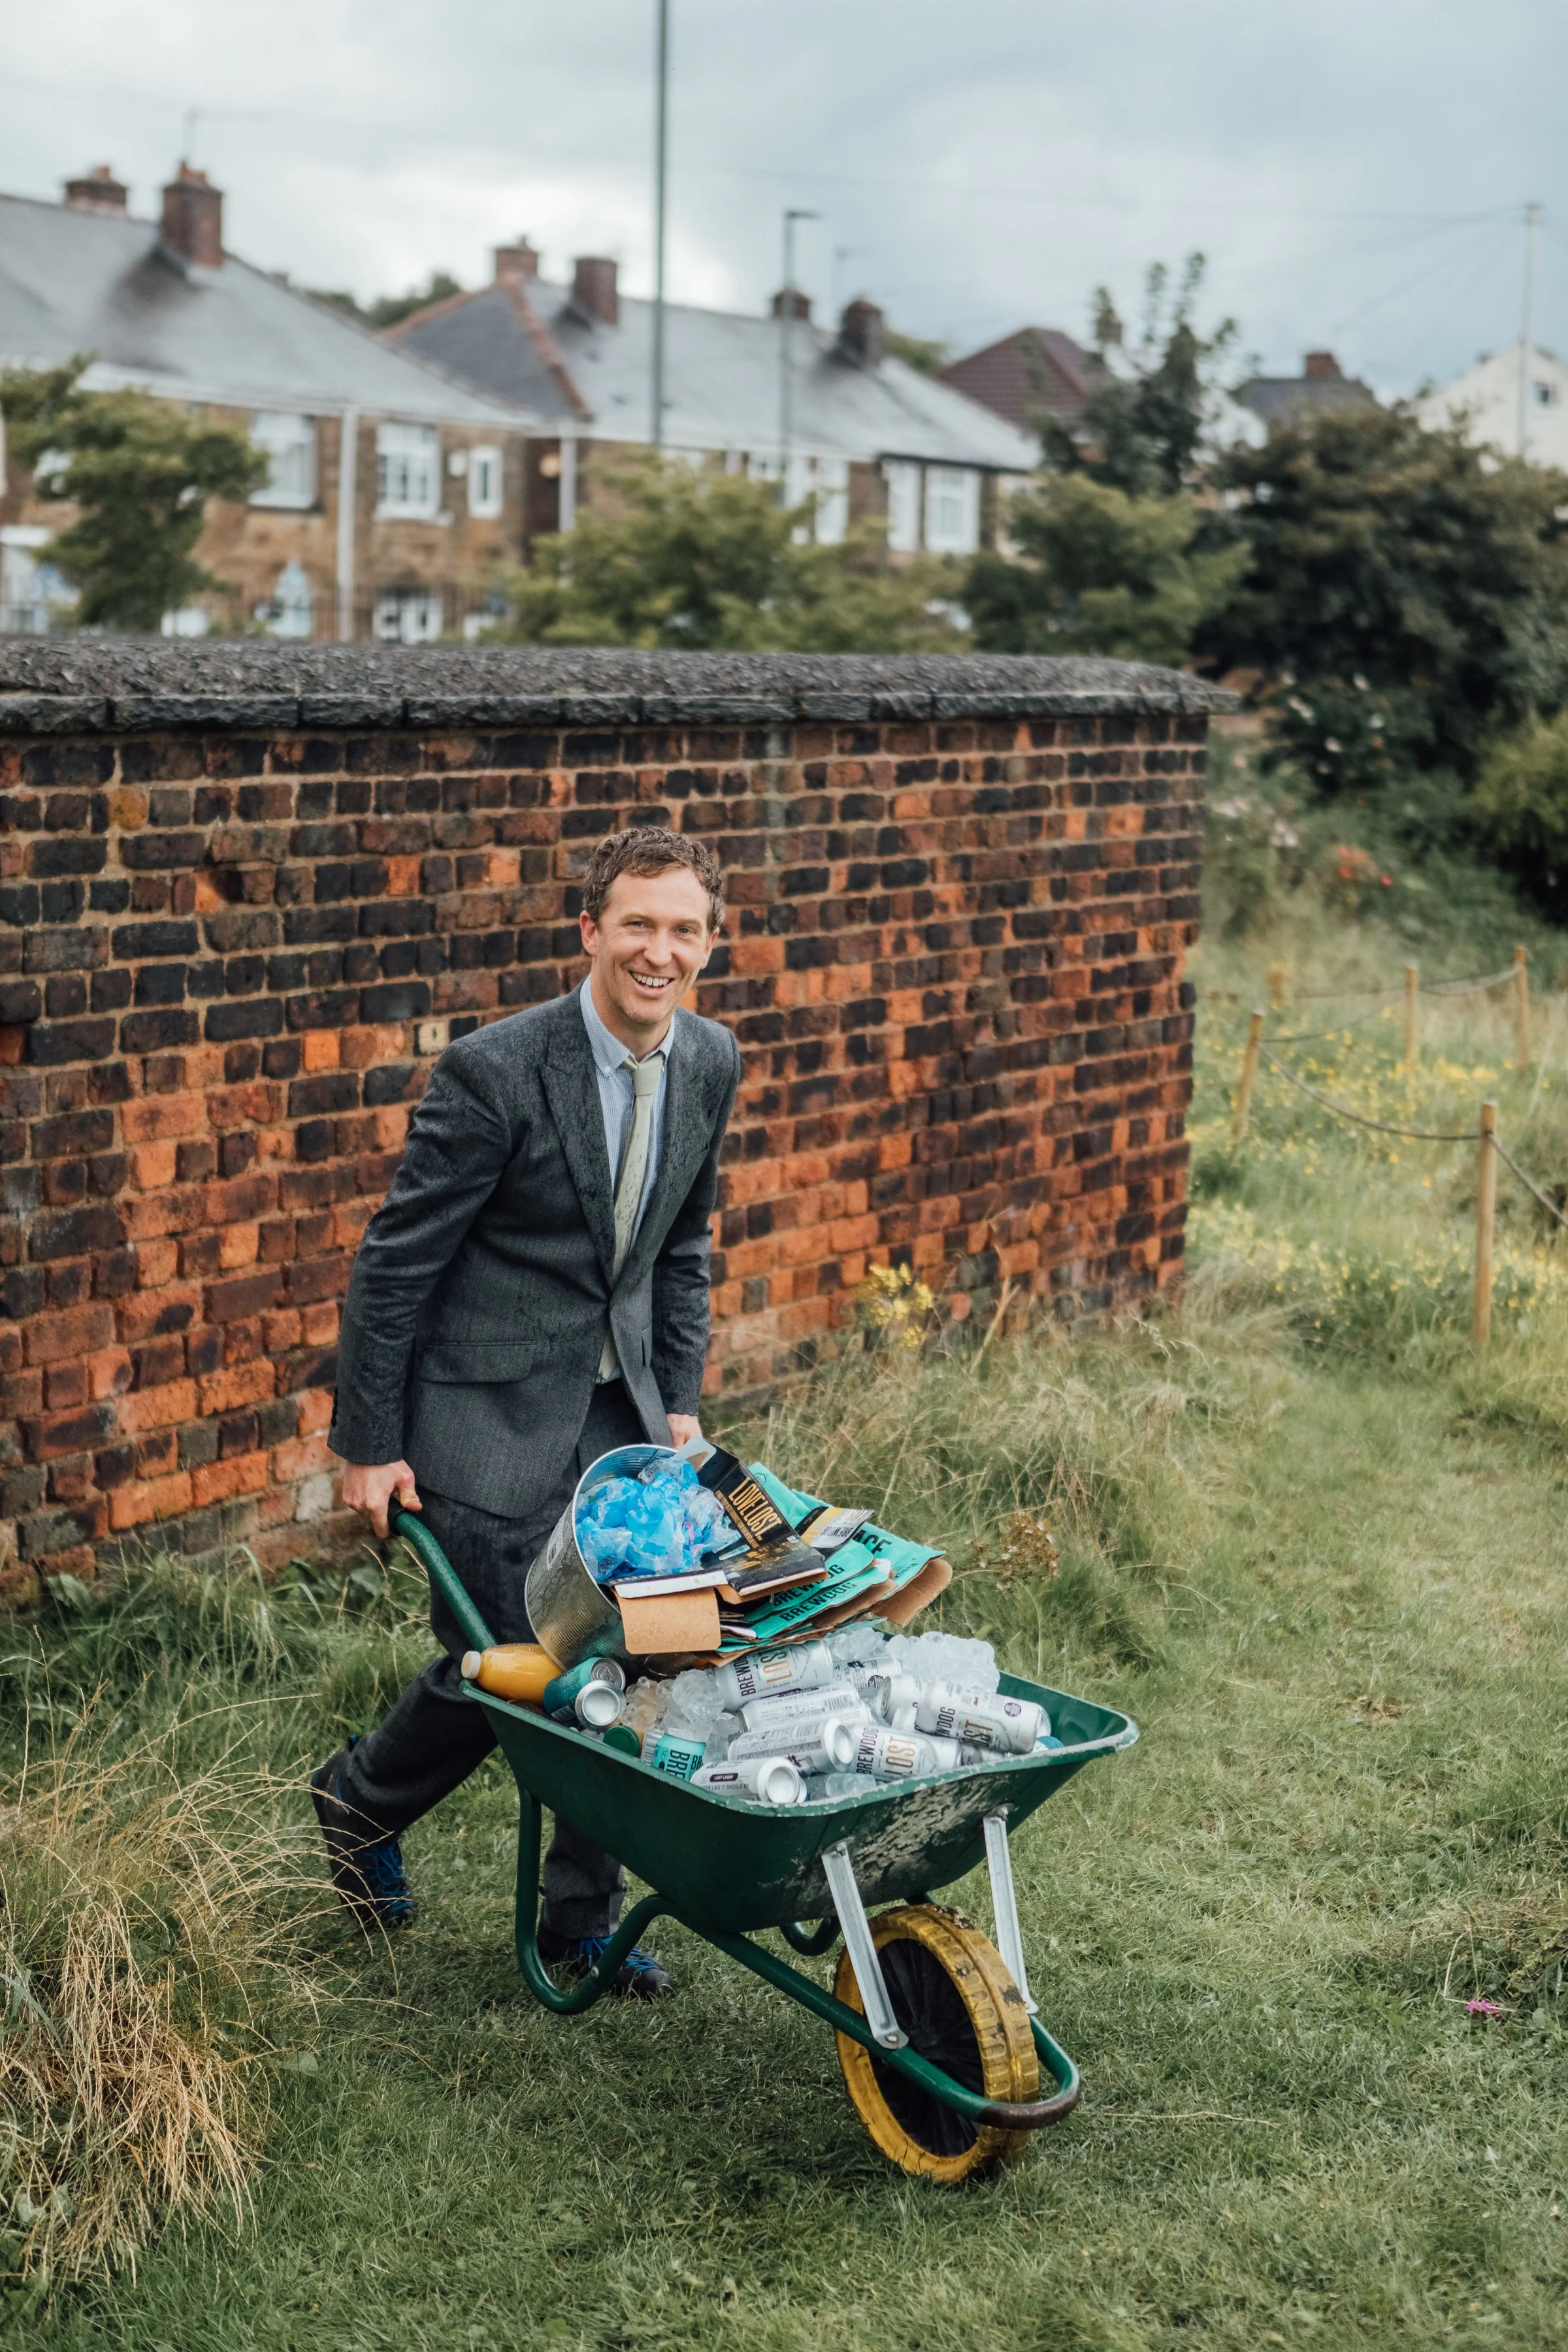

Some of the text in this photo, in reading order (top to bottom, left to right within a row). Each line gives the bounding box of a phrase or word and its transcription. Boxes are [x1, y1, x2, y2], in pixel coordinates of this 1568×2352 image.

[728, 1477, 766, 1516] LOVE
[779, 1582, 857, 1621] BREWDOG
[857, 1727, 879, 1774] BREWDOG
[884, 1736, 917, 1775] LOST
